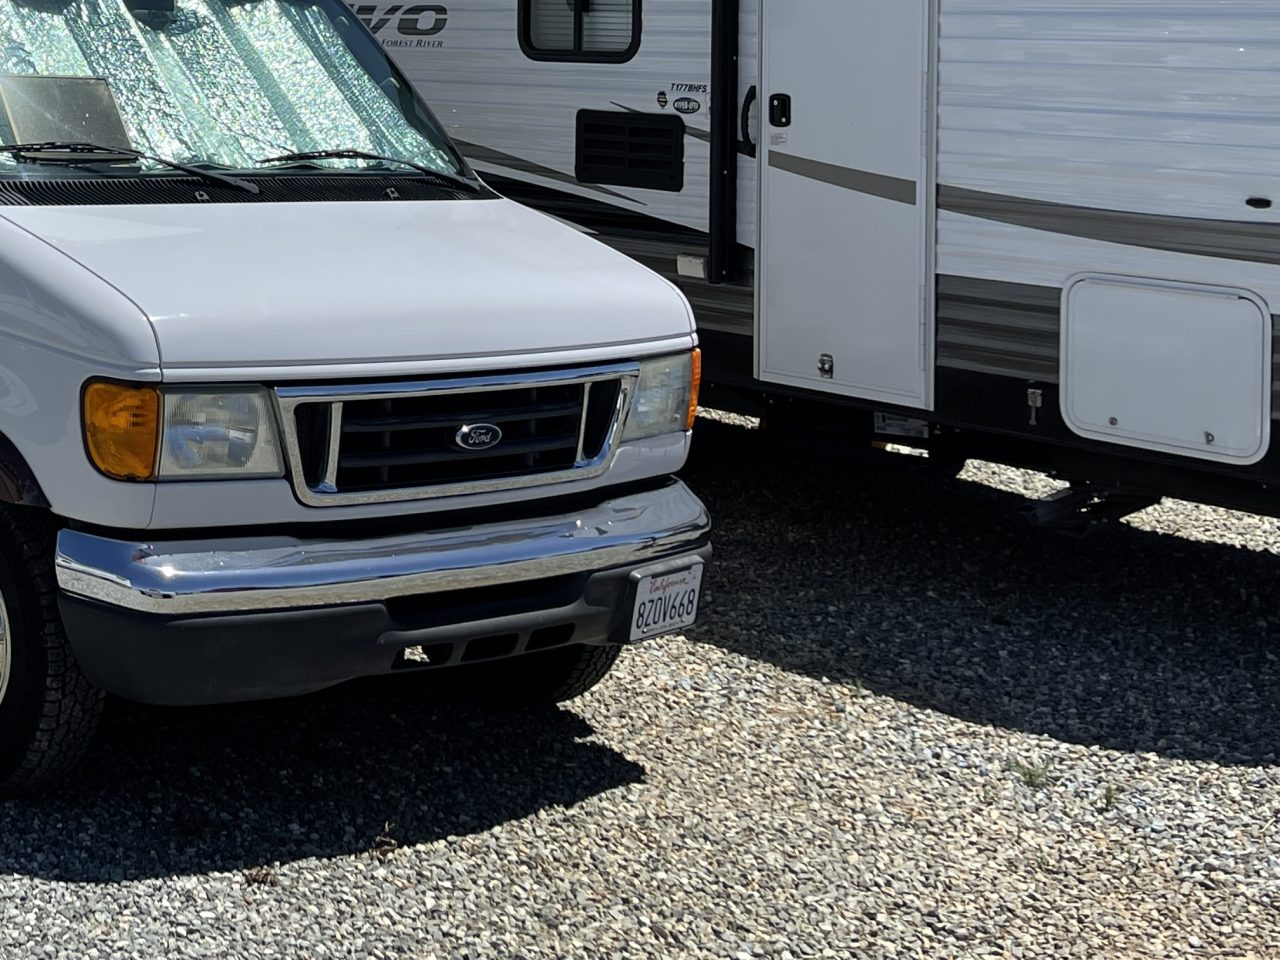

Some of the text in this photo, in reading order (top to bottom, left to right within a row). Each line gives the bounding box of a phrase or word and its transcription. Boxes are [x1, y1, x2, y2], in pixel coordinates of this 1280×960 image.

[380, 39, 444, 49] FOREST RIVER
[468, 429, 492, 444] Ford
